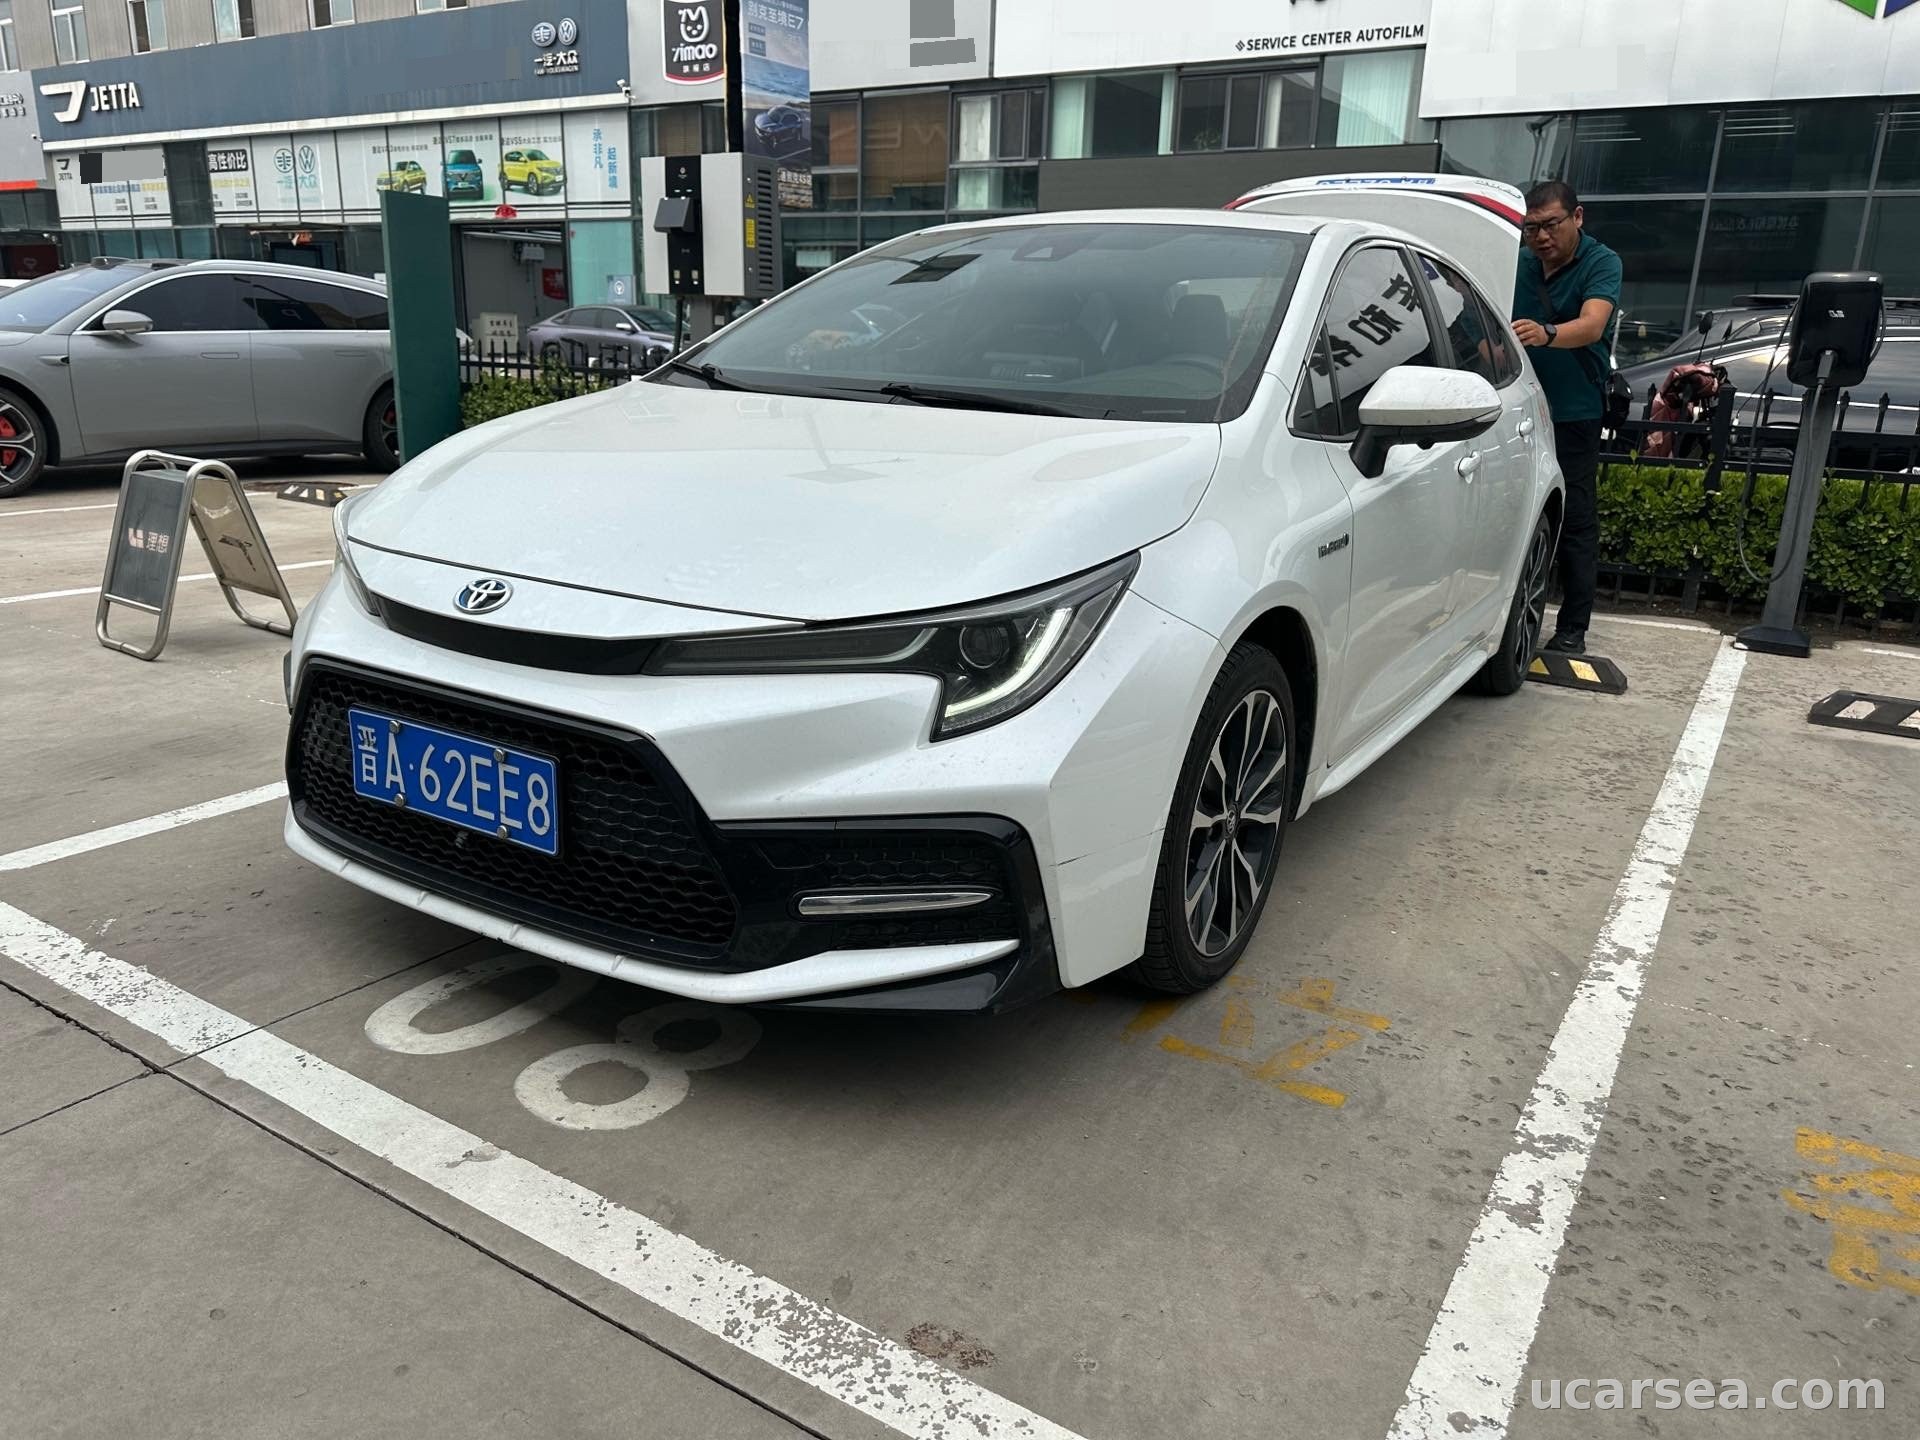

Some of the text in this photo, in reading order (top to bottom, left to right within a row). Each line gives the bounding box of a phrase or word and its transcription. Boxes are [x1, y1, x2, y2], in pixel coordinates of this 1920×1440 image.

[1246, 23, 1425, 51] SERVICE CENTER AUTOFILM
[90, 82, 140, 112] JETTA
[208, 152, 248, 171] 高性价比
